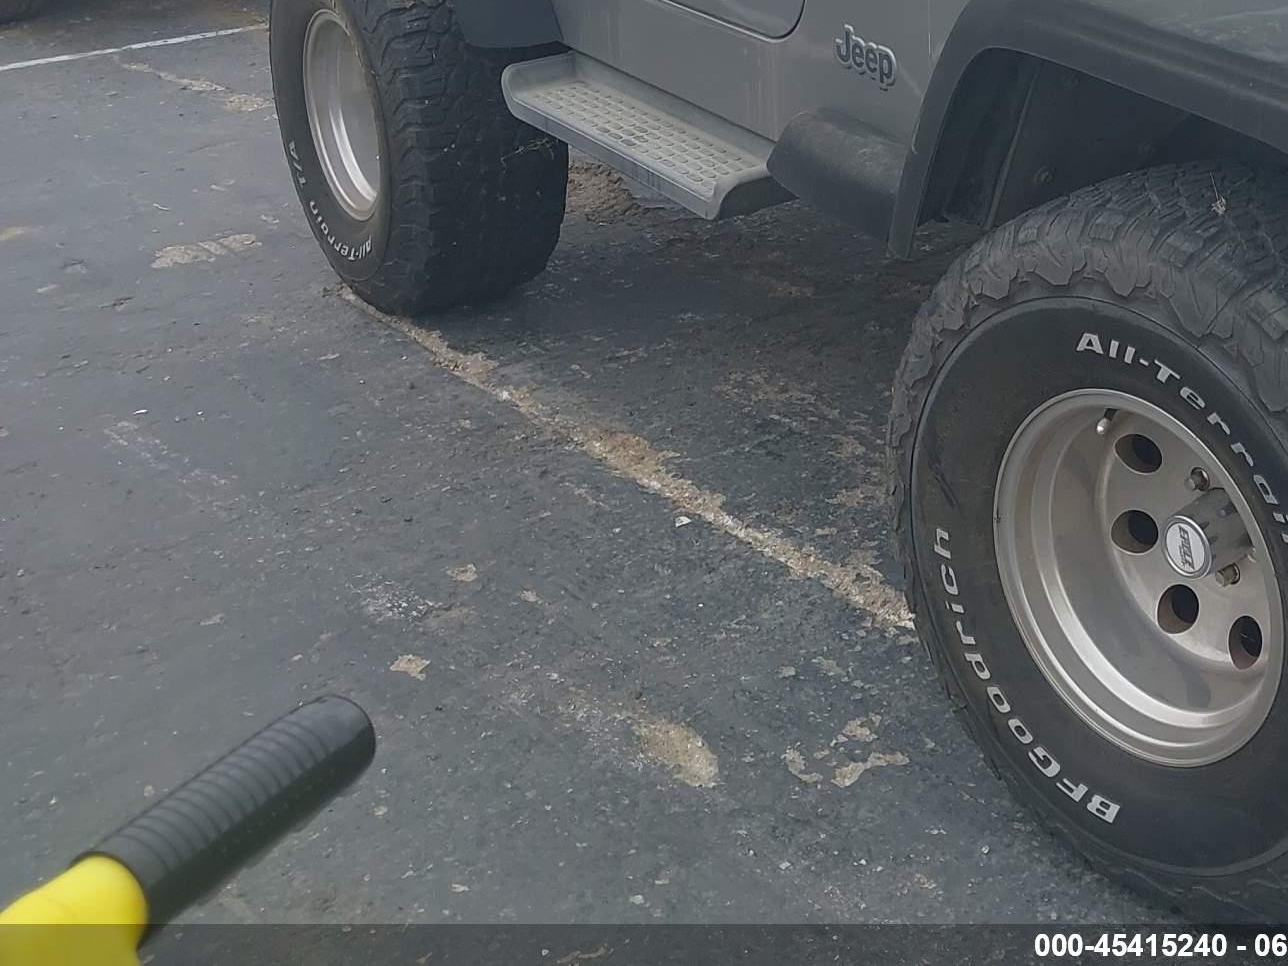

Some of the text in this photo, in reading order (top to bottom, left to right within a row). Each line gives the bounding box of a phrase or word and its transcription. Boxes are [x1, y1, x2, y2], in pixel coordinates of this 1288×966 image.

[835, 24, 897, 90] Jeep
[310, 201, 372, 261] All-Terrain
[933, 528, 1121, 824] BFGoodrich
